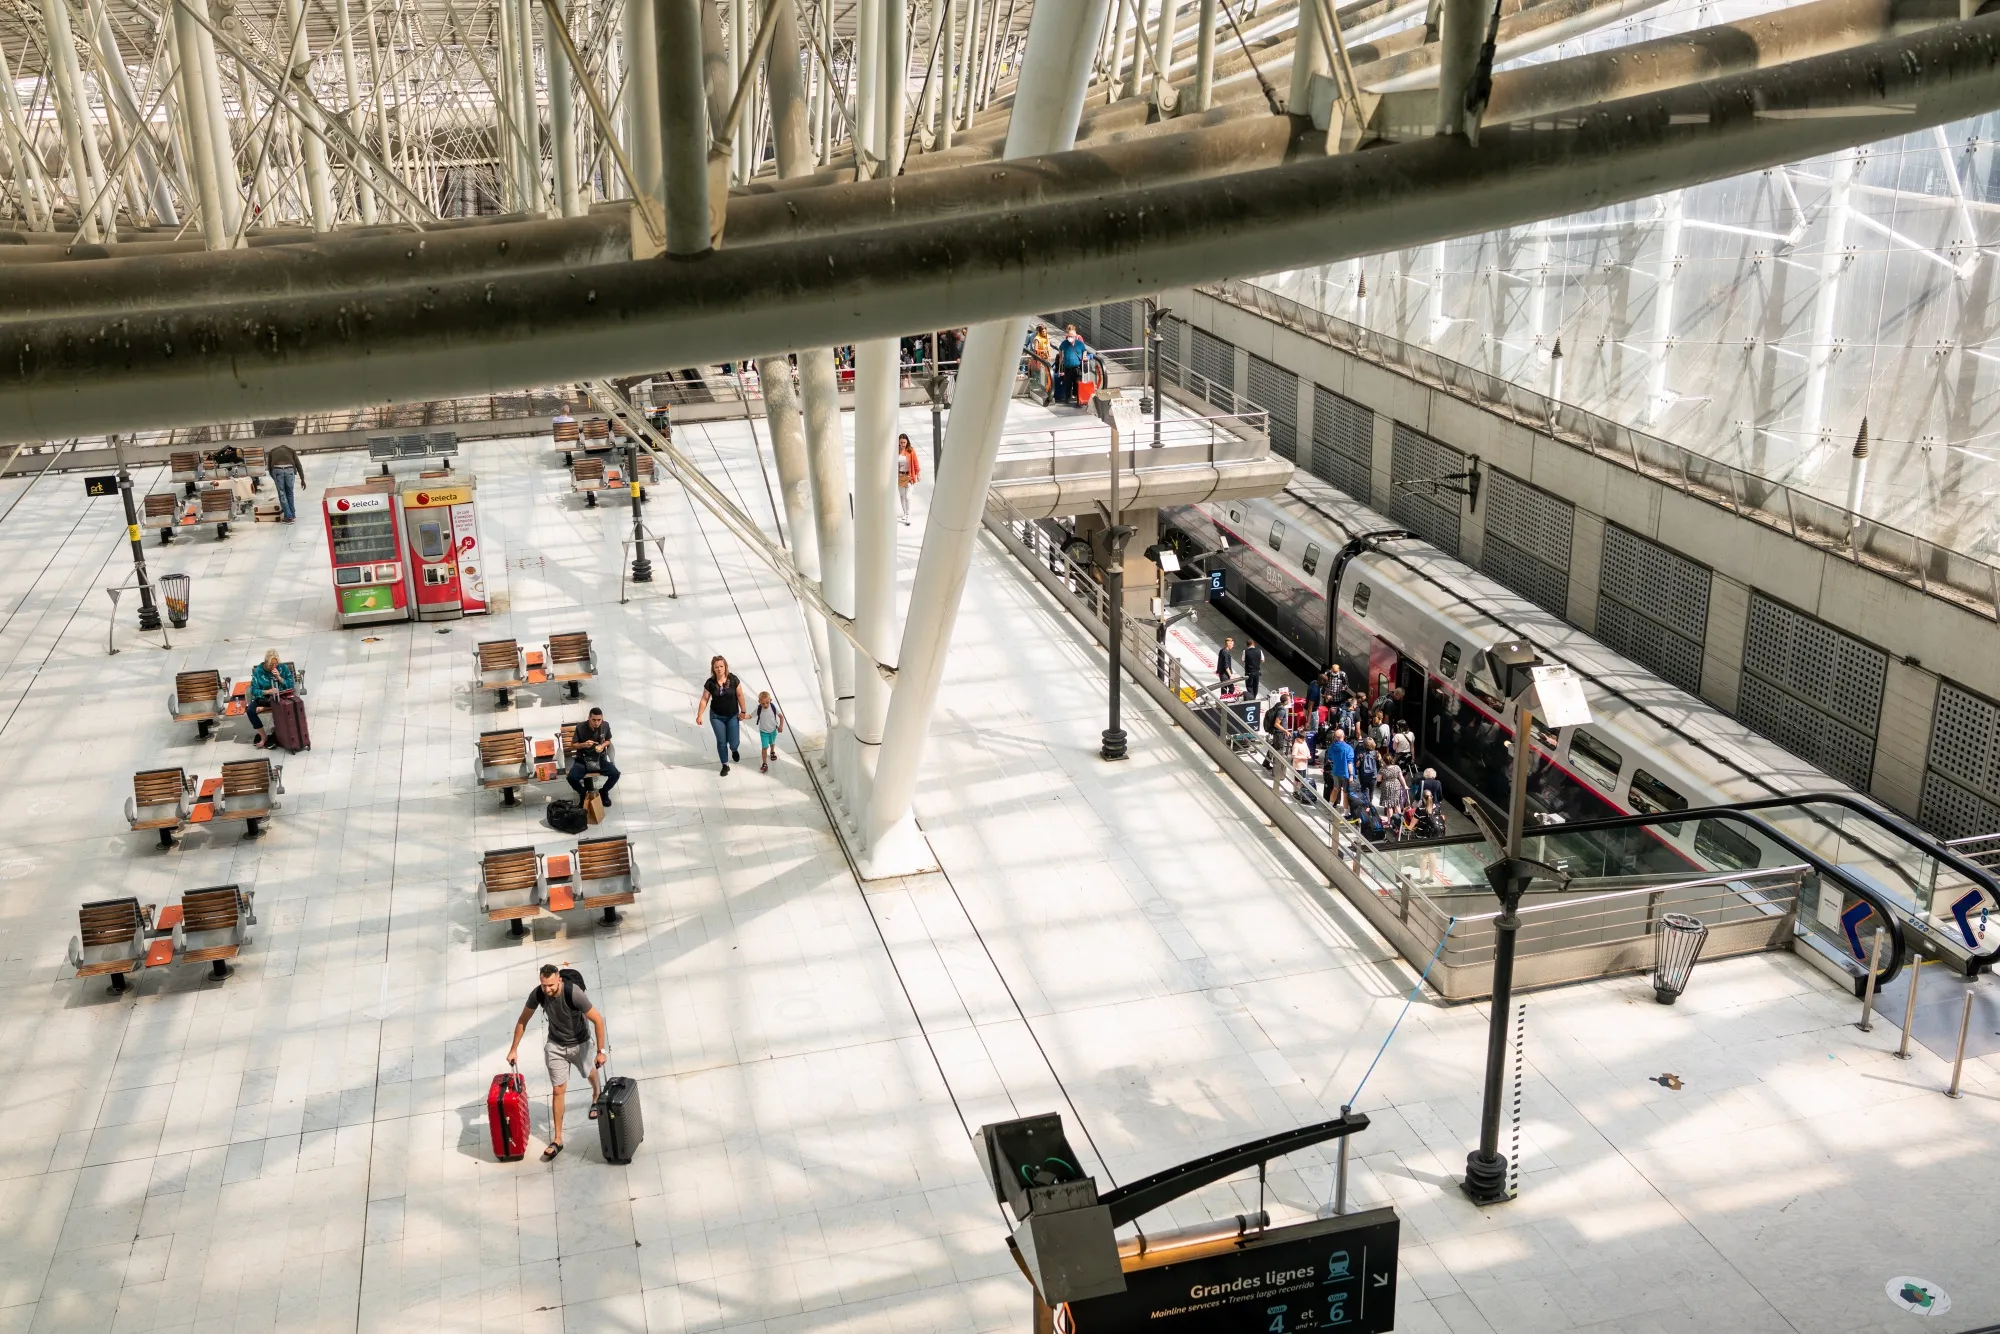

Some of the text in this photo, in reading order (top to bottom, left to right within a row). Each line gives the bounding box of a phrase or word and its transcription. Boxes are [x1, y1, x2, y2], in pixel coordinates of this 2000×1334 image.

[351, 499, 379, 508] selecta
[430, 494, 458, 502] selecta
[1266, 565, 1283, 588] BAR
[1212, 577, 1220, 588] 6
[1246, 711, 1254, 722] 6
[1432, 714, 1441, 744] 1
[1190, 1266, 1315, 1299] Grandes lignes
[1150, 1281, 1315, 1320] Mainline services Trenes largo recorrido
[1269, 1306, 1284, 1314] Voie
[1268, 1302, 1344, 1333] 4 et 6
[1295, 1322, 1308, 1330] and
